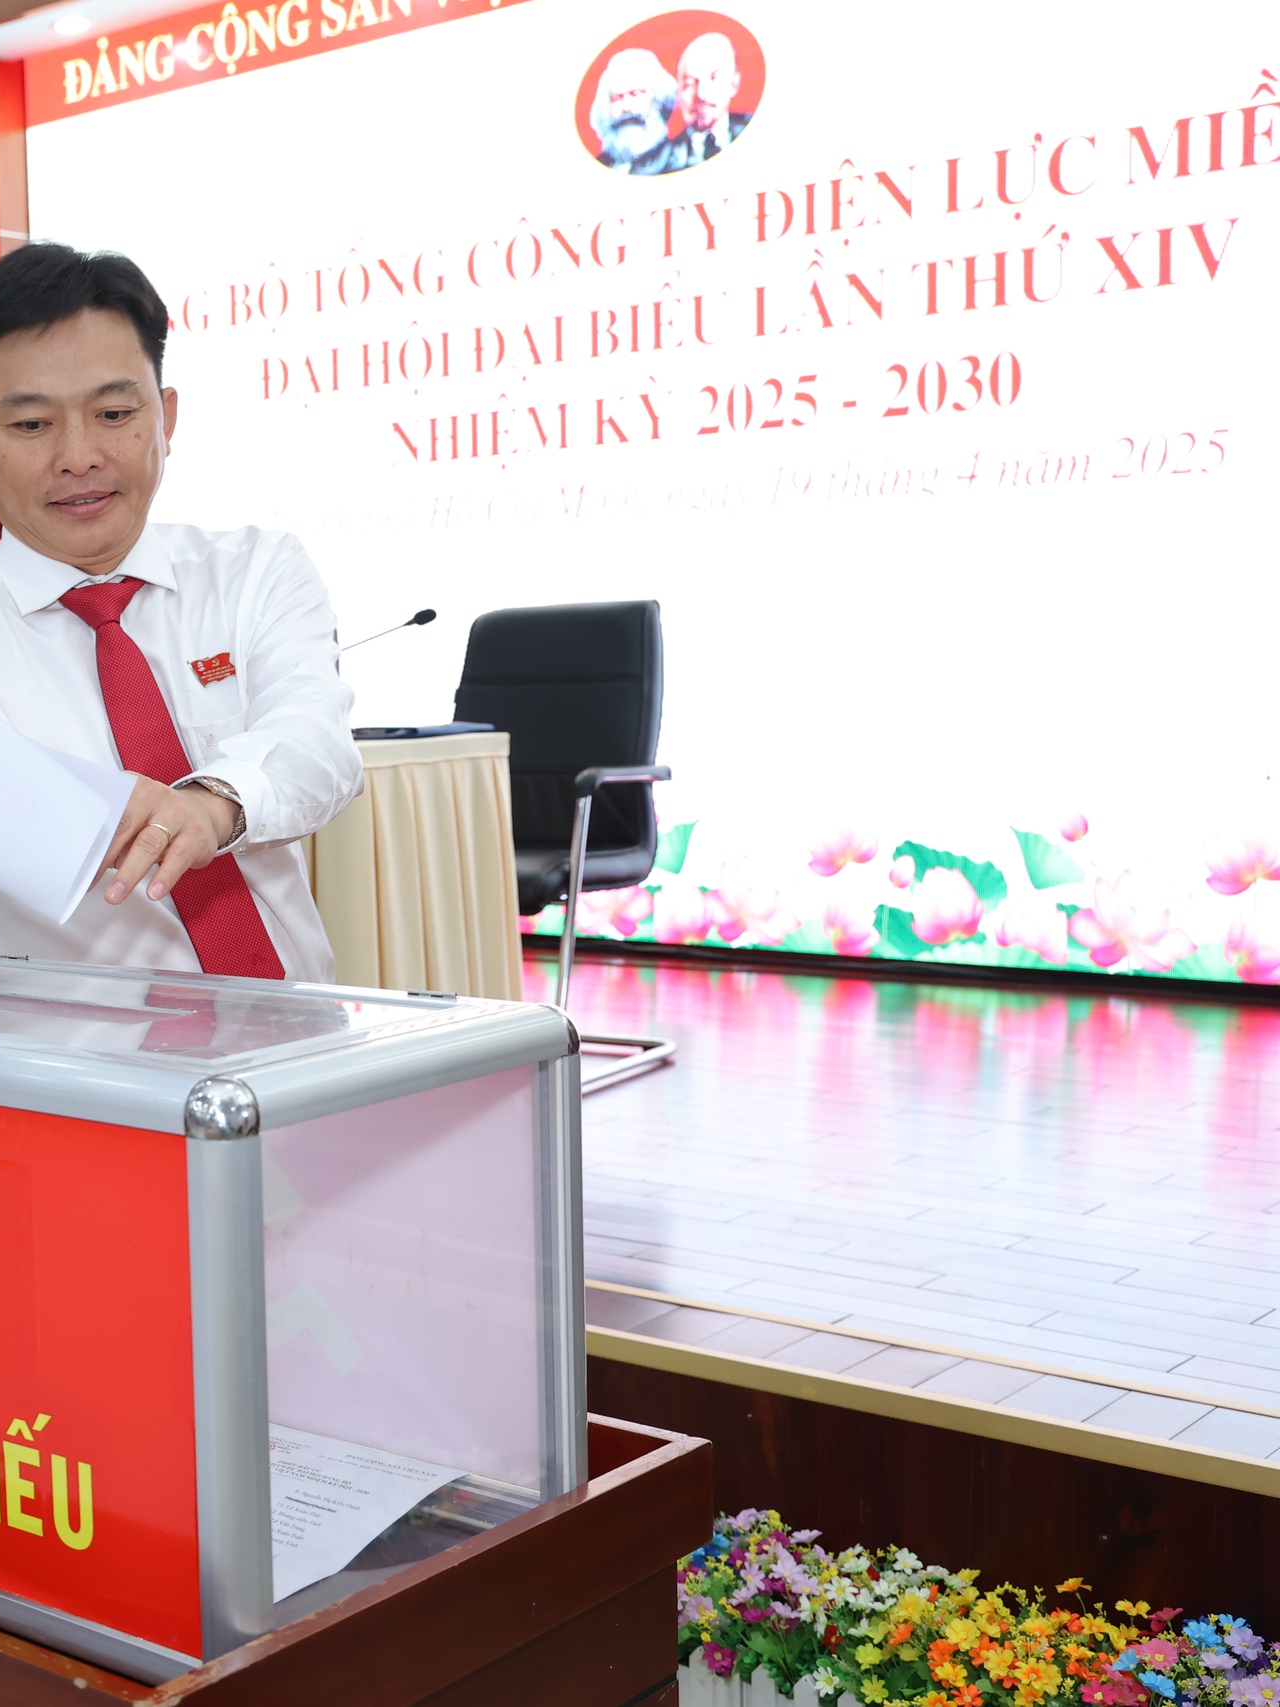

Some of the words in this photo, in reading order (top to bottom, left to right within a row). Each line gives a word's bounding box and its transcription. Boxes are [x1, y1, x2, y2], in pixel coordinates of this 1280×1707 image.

[63, 36, 175, 105] ĐẢNG
[184, 2, 312, 75] CỘNG
[228, 262, 289, 333] BỘ
[306, 236, 445, 314] TỔNG
[467, 217, 627, 288] CÔNG
[650, 198, 729, 258] TY
[753, 158, 916, 246] ĐIỆN
[944, 132, 1097, 222] LỰC
[261, 347, 340, 409] ĐẠI
[362, 320, 451, 395] HỘI
[473, 315, 565, 382] ĐẠI
[589, 270, 728, 358] BIỂU
[754, 248, 886, 338] LẦN
[910, 224, 1071, 317] THỨ
[1094, 217, 1240, 295] XIV
[391, 393, 569, 471] NHIỆM
[595, 374, 672, 446] KỲ
[696, 374, 819, 436] 2025
[881, 351, 1022, 418] 2030
[956, 450, 982, 487] 4
[997, 445, 1091, 488] năm
[1111, 428, 1232, 480] 2025
